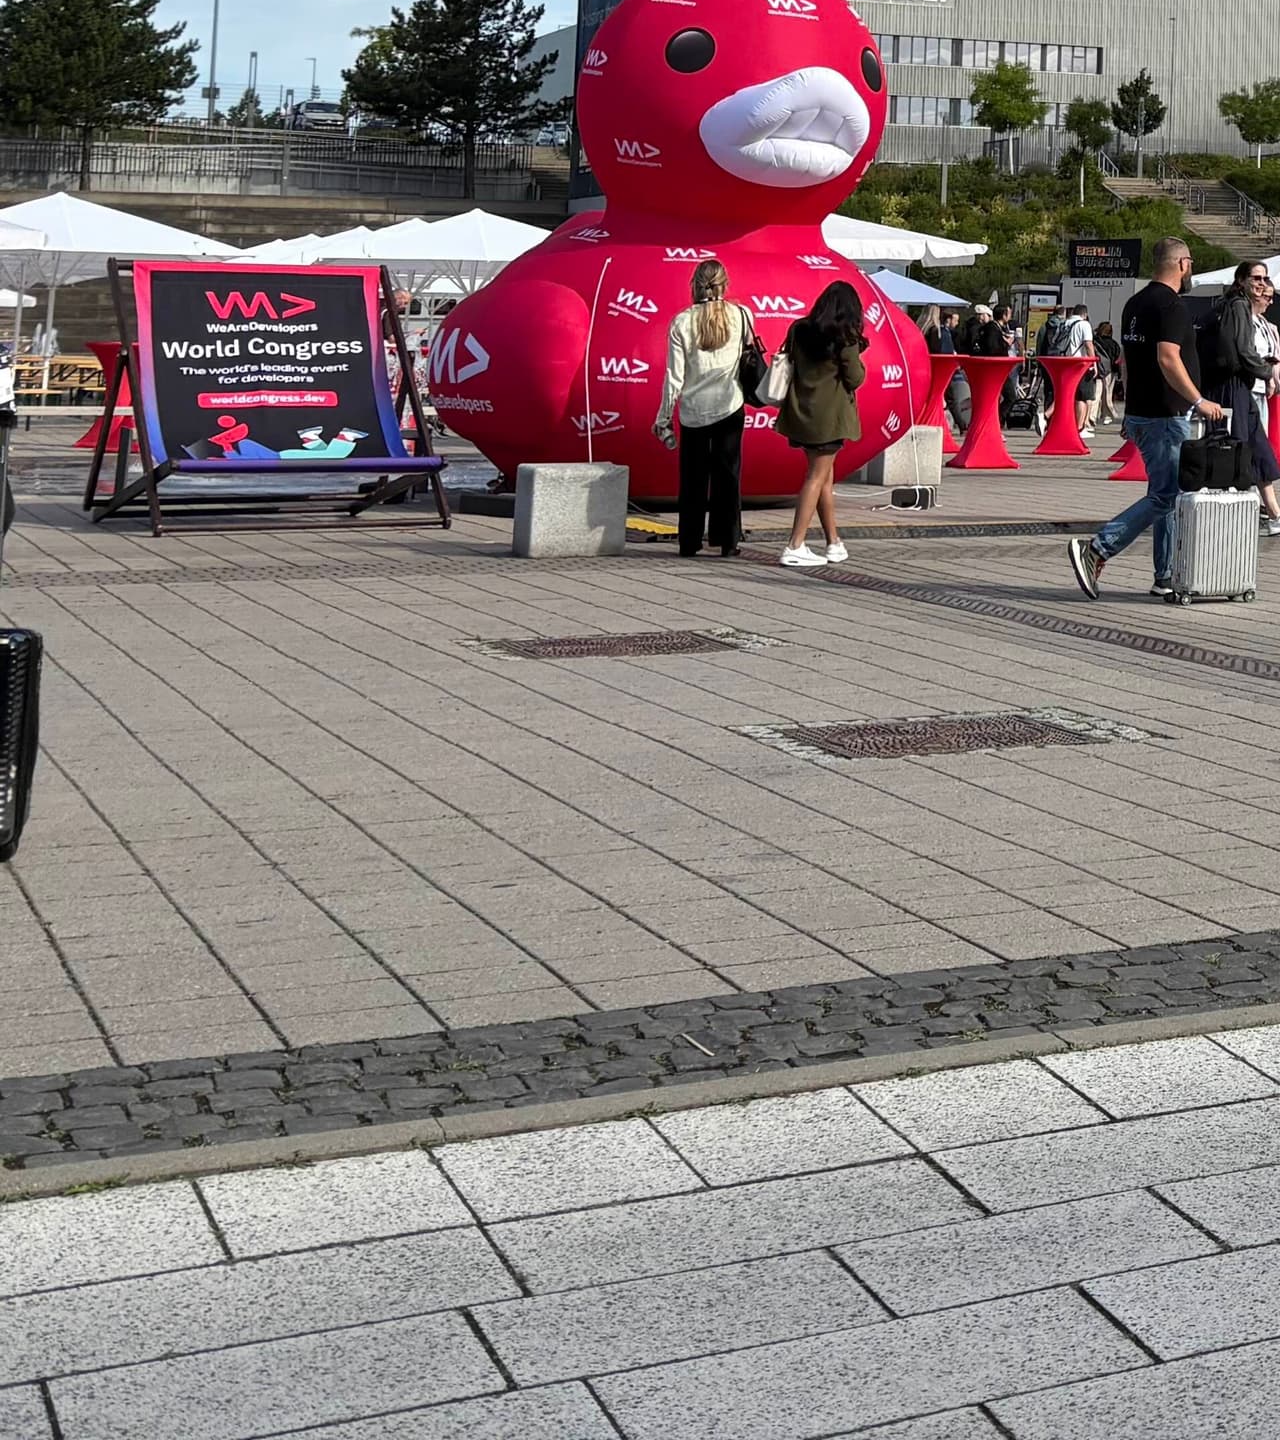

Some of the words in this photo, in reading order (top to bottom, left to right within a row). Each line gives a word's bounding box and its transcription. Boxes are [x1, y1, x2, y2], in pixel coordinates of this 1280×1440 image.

[206, 321, 319, 335] WeAreDevelopers
[161, 338, 240, 359] World
[248, 338, 363, 360] Congress
[179, 366, 207, 376] The
[208, 363, 259, 375] world's
[260, 362, 309, 375] leading
[310, 363, 349, 373] event
[218, 374, 238, 385] for
[240, 373, 314, 384] developers
[210, 392, 326, 405] worldcongress.dev
